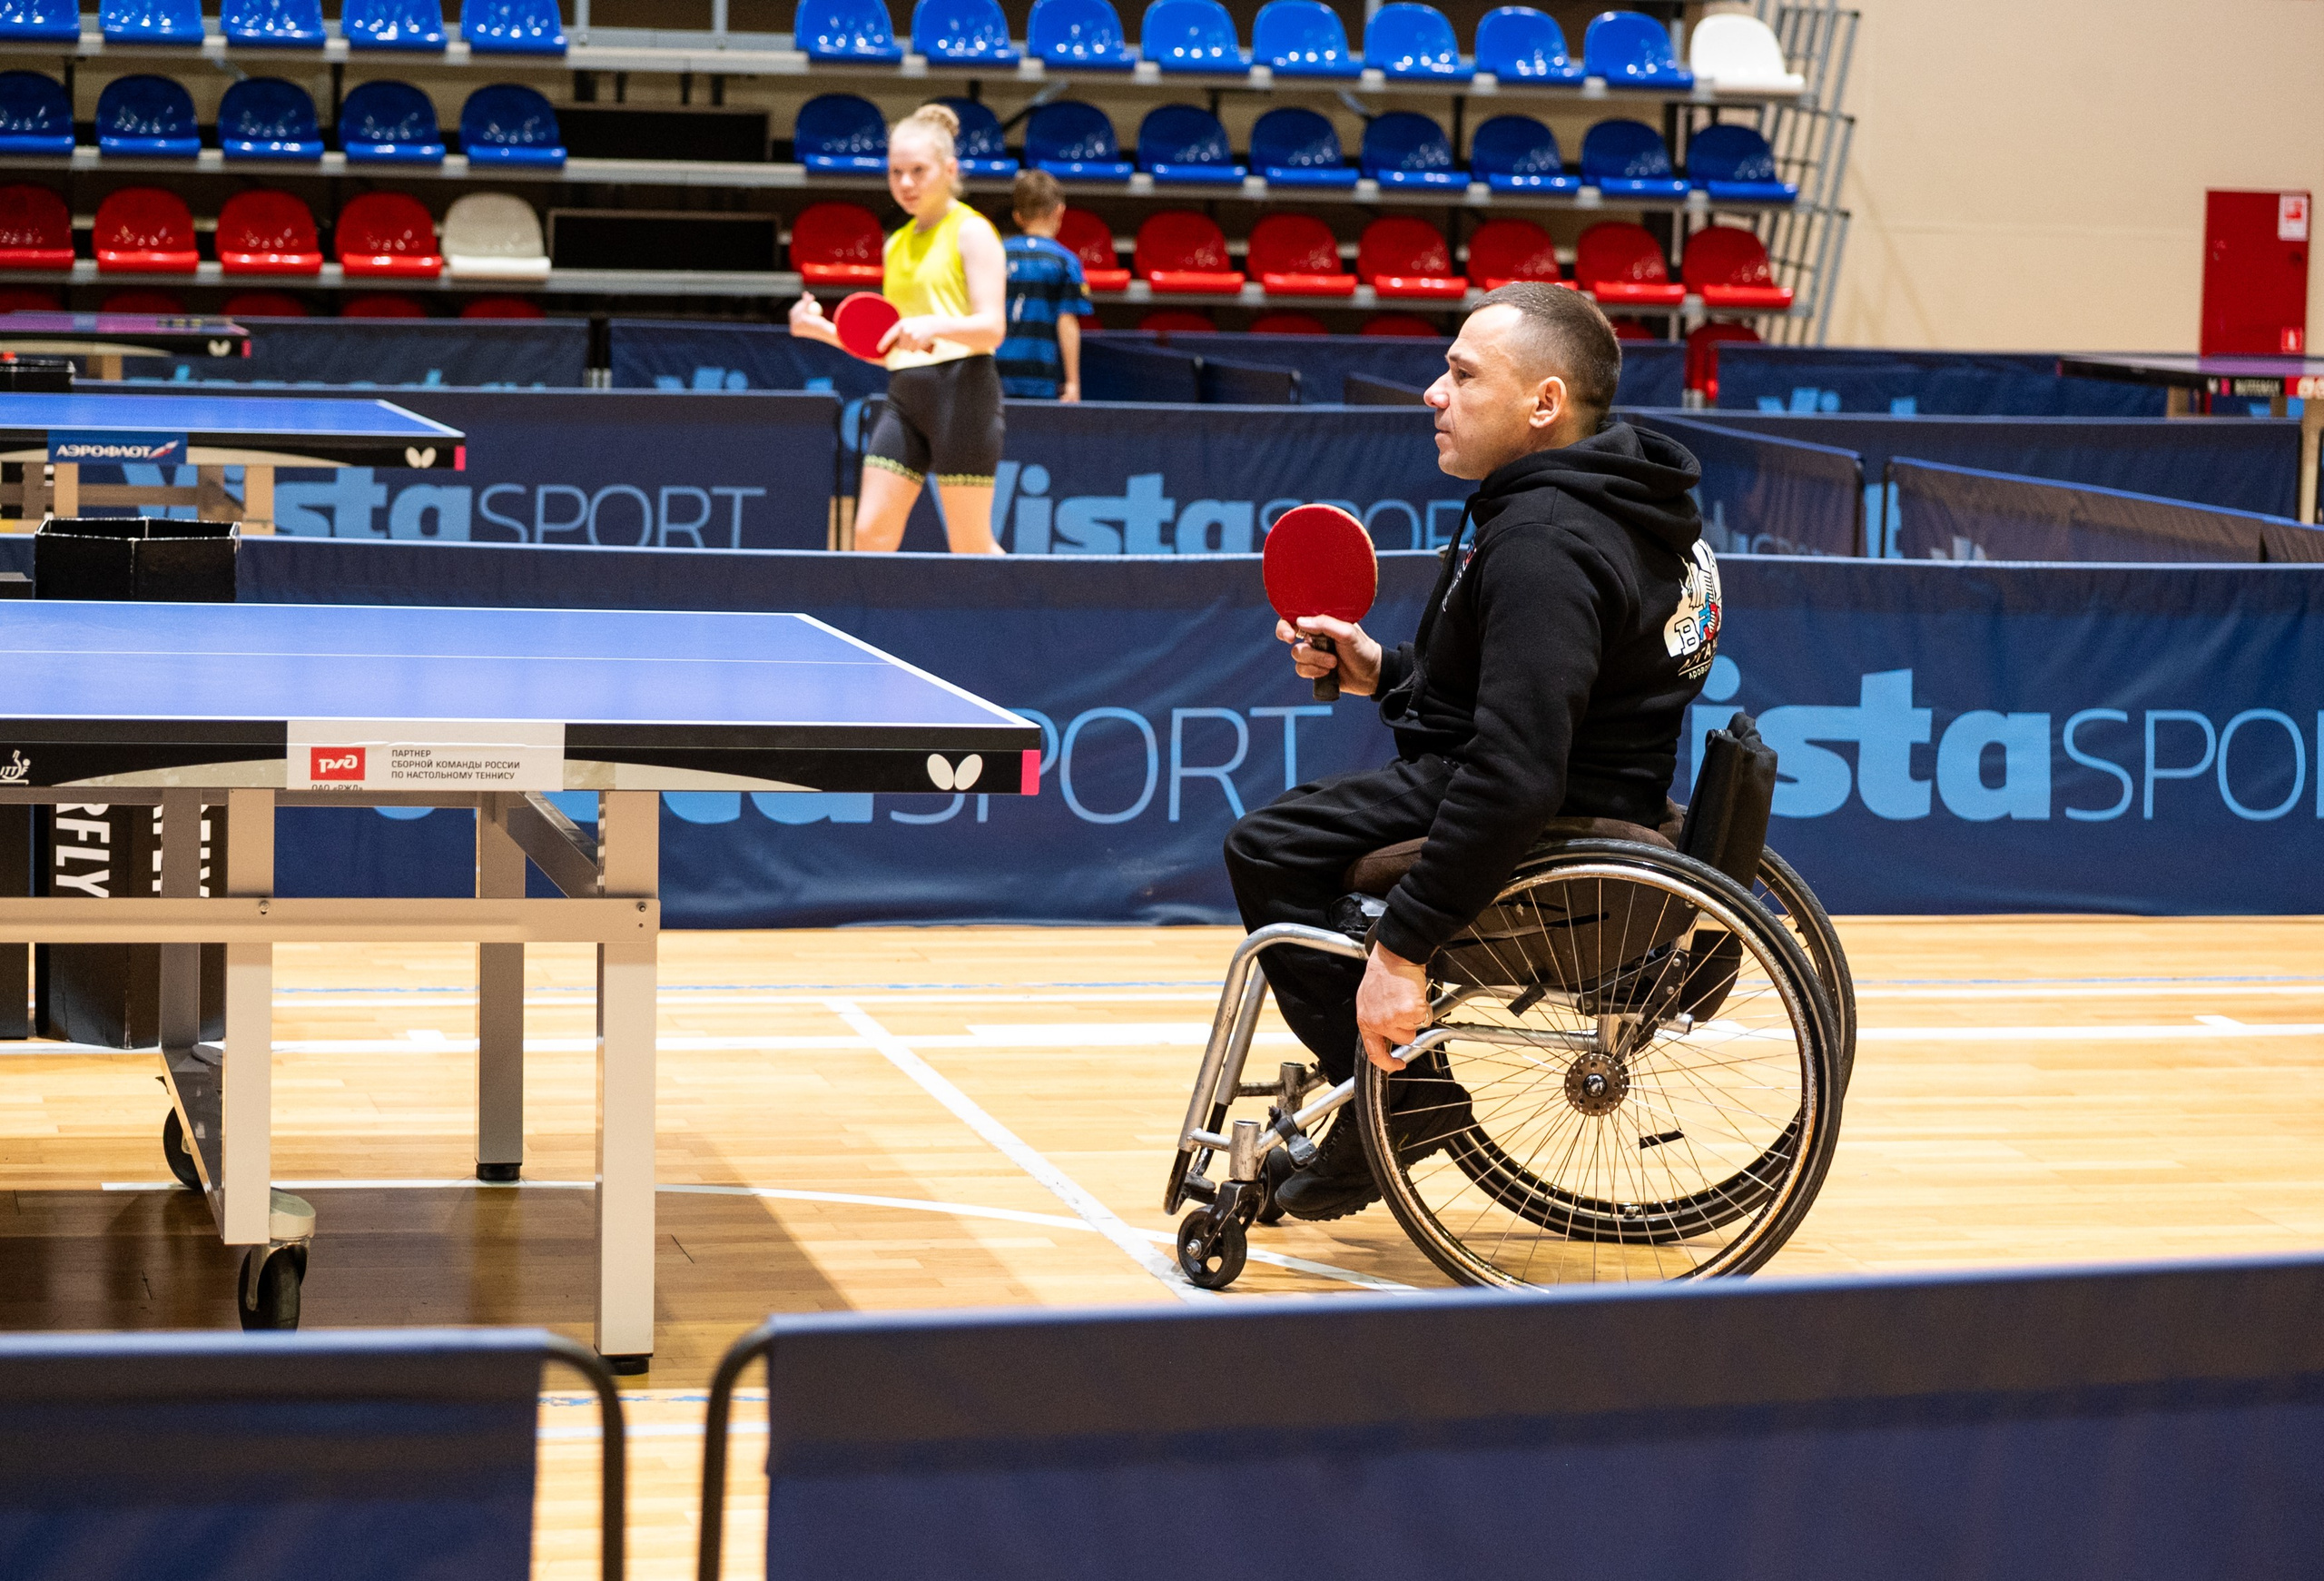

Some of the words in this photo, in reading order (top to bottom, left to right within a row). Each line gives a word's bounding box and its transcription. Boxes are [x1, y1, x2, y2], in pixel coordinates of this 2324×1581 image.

[56, 444, 153, 459] АЭРОФЛОТ
[391, 749, 431, 757] ПАРТНЕР
[391, 759, 433, 768] СБОРНОЙ
[436, 760, 483, 769] КОМАНДЫ
[485, 761, 520, 769] РОССИИ
[391, 771, 405, 779] ПО
[406, 771, 473, 780] НАСТОЛЬНОМУ
[475, 771, 516, 780] ТЕННИСУ
